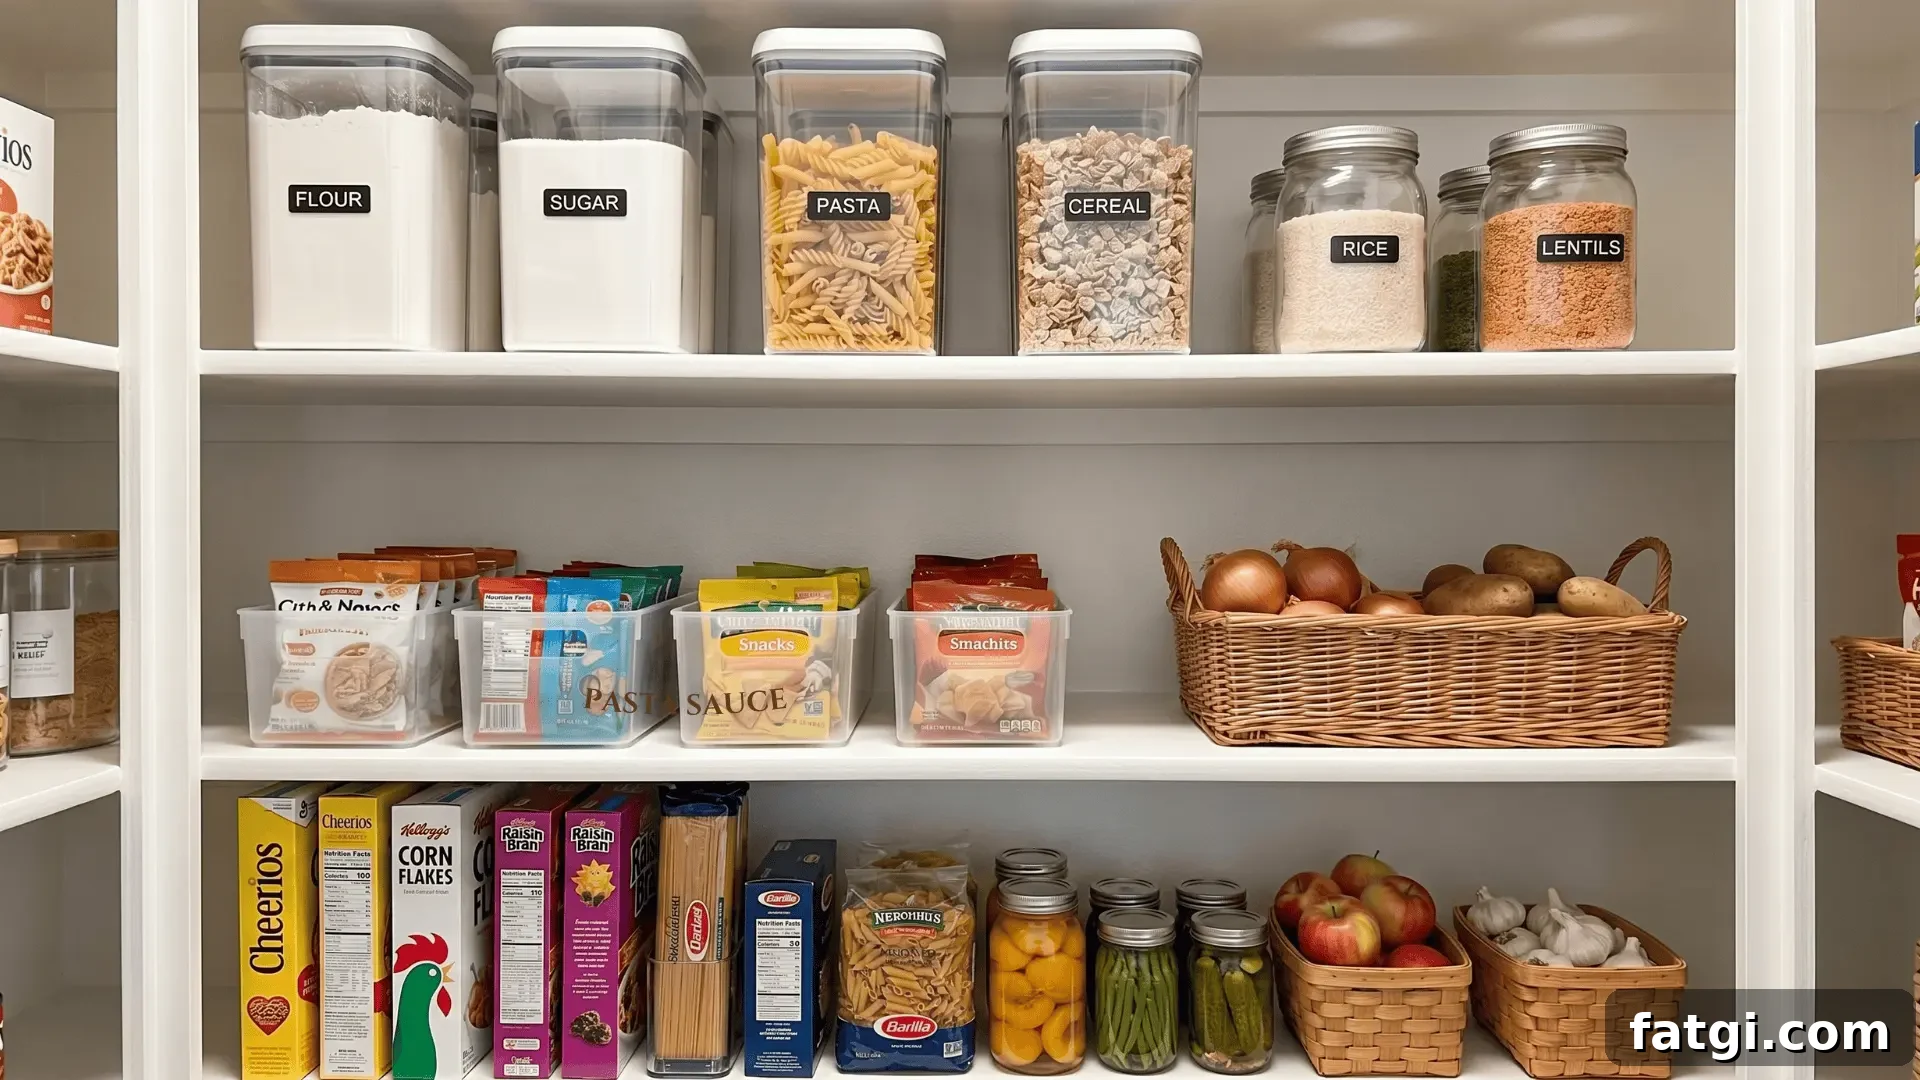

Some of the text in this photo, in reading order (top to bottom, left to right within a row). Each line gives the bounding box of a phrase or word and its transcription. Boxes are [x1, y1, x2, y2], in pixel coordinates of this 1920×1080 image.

[296, 191, 363, 208] FLOUR
[550, 194, 619, 211] SUGAR
[816, 198, 881, 214] PASTA
[1068, 198, 1147, 215] CEREAL
[1344, 241, 1388, 257] RICE
[1542, 240, 1621, 256] LENTILS
[739, 637, 795, 651] Snacks
[950, 637, 1018, 651] Smachits
[686, 687, 787, 716] SAUCE
[322, 814, 372, 829] Cheerios
[400, 822, 451, 840] Kellogg's
[502, 826, 543, 841] Raisin
[572, 826, 613, 842] Raisin
[507, 839, 538, 851] Bran
[577, 839, 608, 851] Bran
[398, 845, 453, 867] CORN
[398, 868, 454, 885] FLAKES
[248, 842, 285, 976] Cheerios
